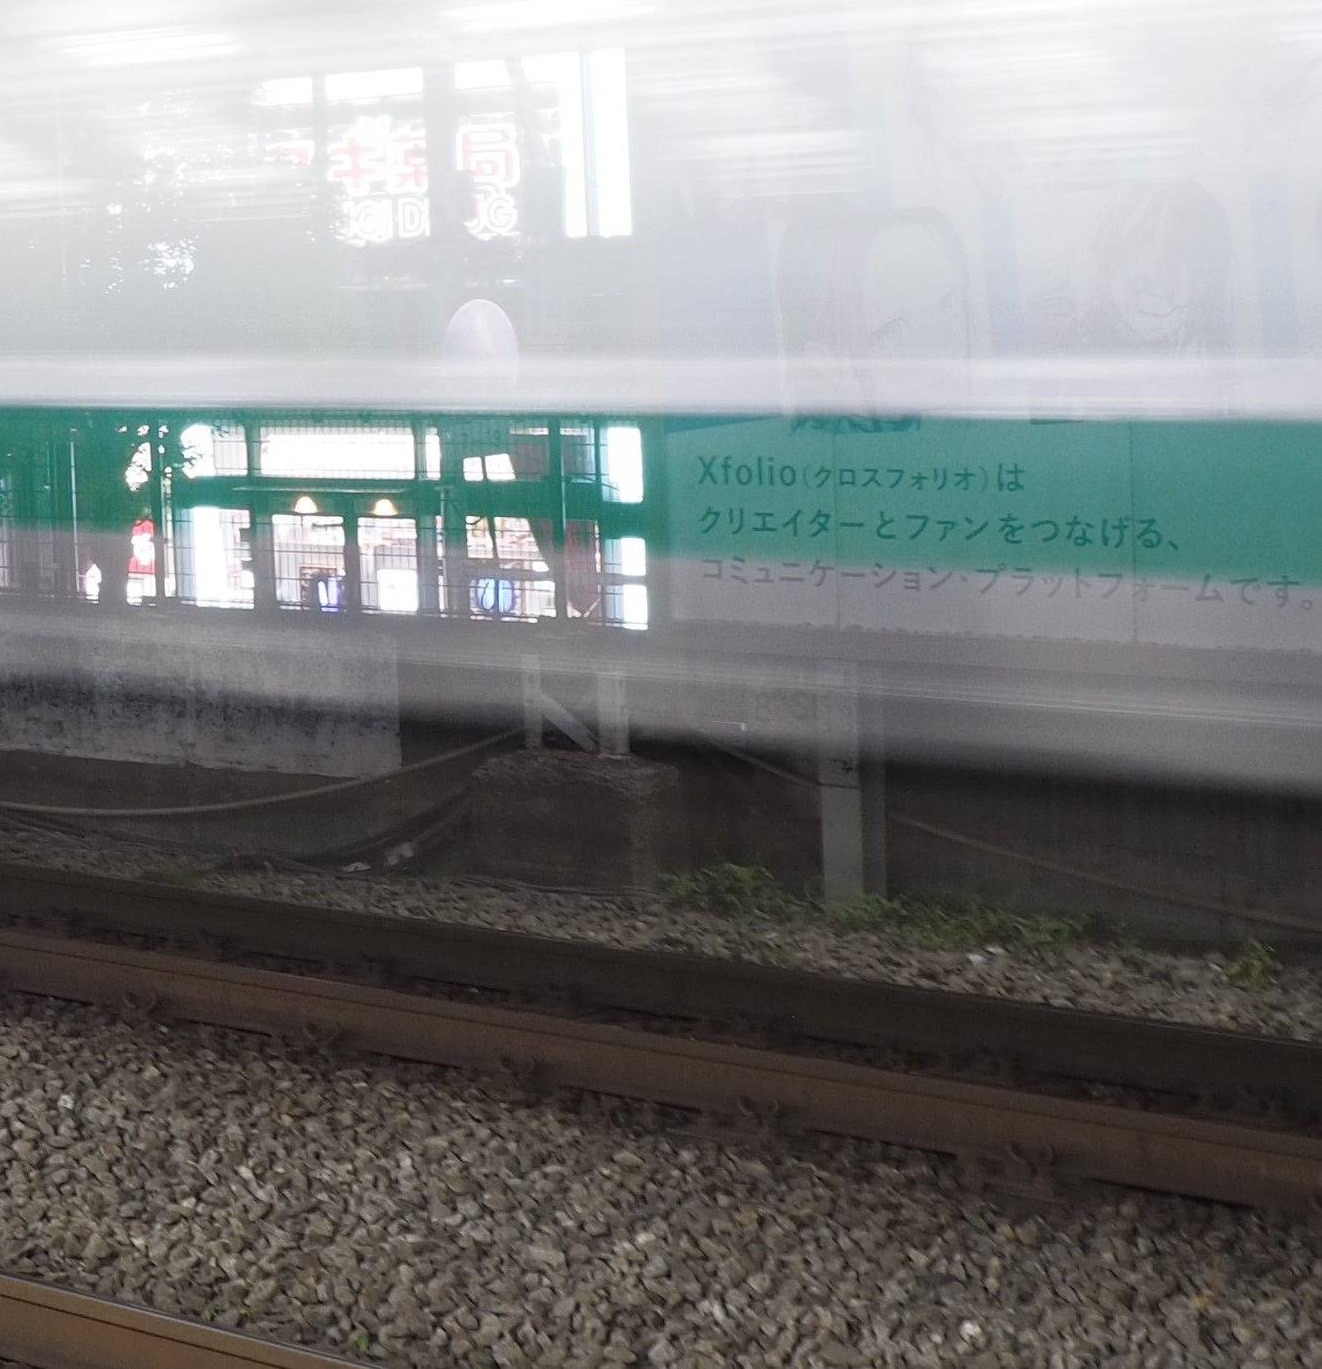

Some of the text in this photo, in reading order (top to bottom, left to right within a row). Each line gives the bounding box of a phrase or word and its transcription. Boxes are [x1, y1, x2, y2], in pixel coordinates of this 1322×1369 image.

[697, 504, 1181, 553] クリエイターとファンをつなげる、
